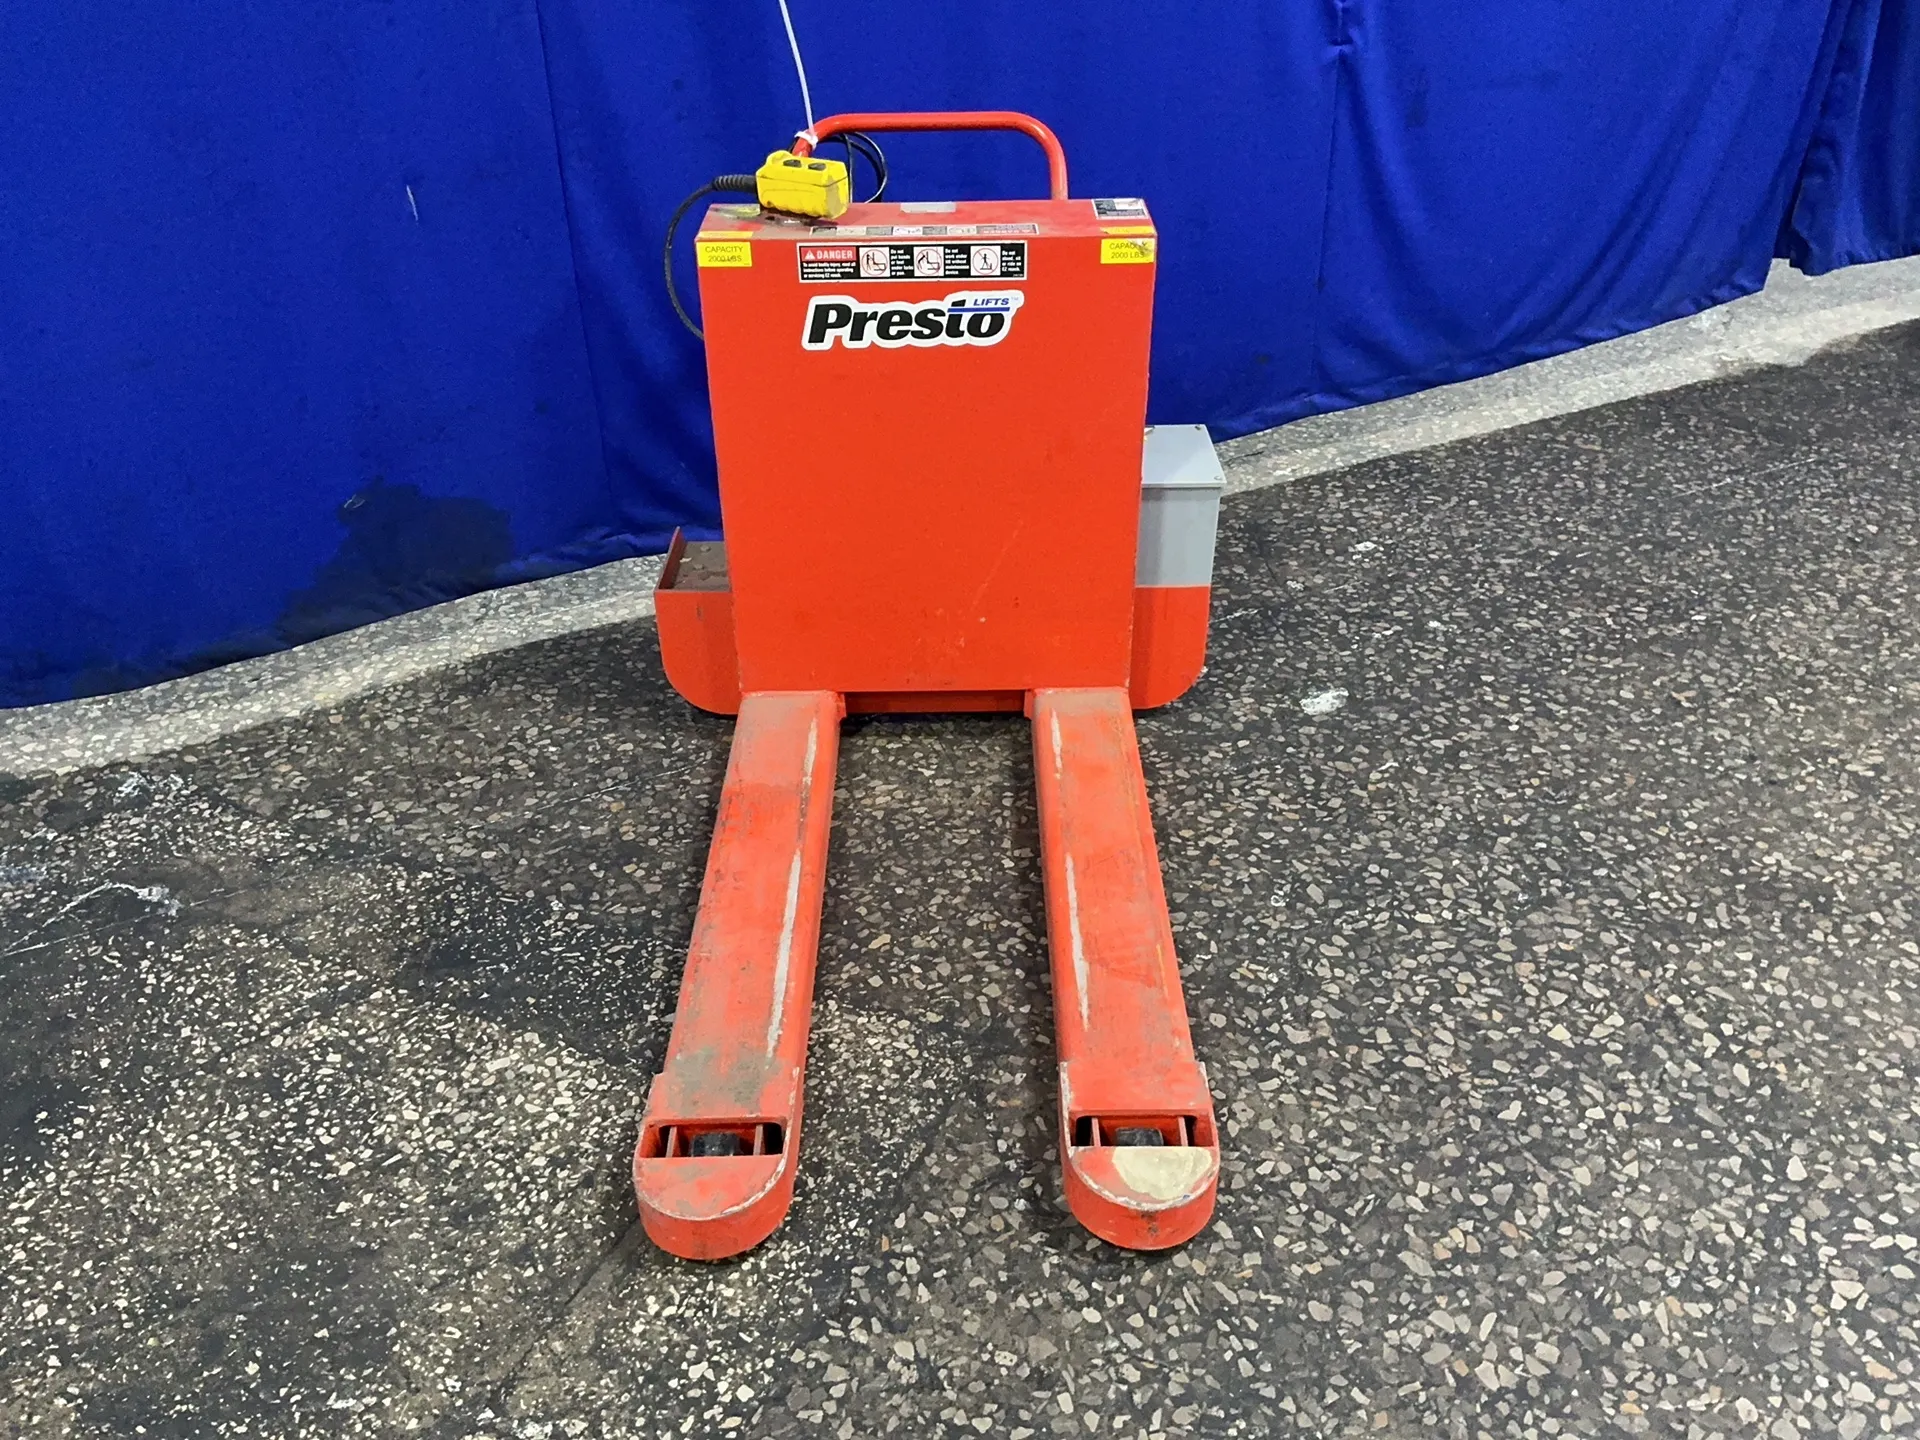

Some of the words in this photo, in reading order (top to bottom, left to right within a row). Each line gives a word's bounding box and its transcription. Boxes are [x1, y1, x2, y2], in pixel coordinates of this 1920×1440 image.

[816, 250, 852, 259] DANGER
[973, 298, 1009, 306] LIFTS
[808, 299, 1005, 344] Presto
